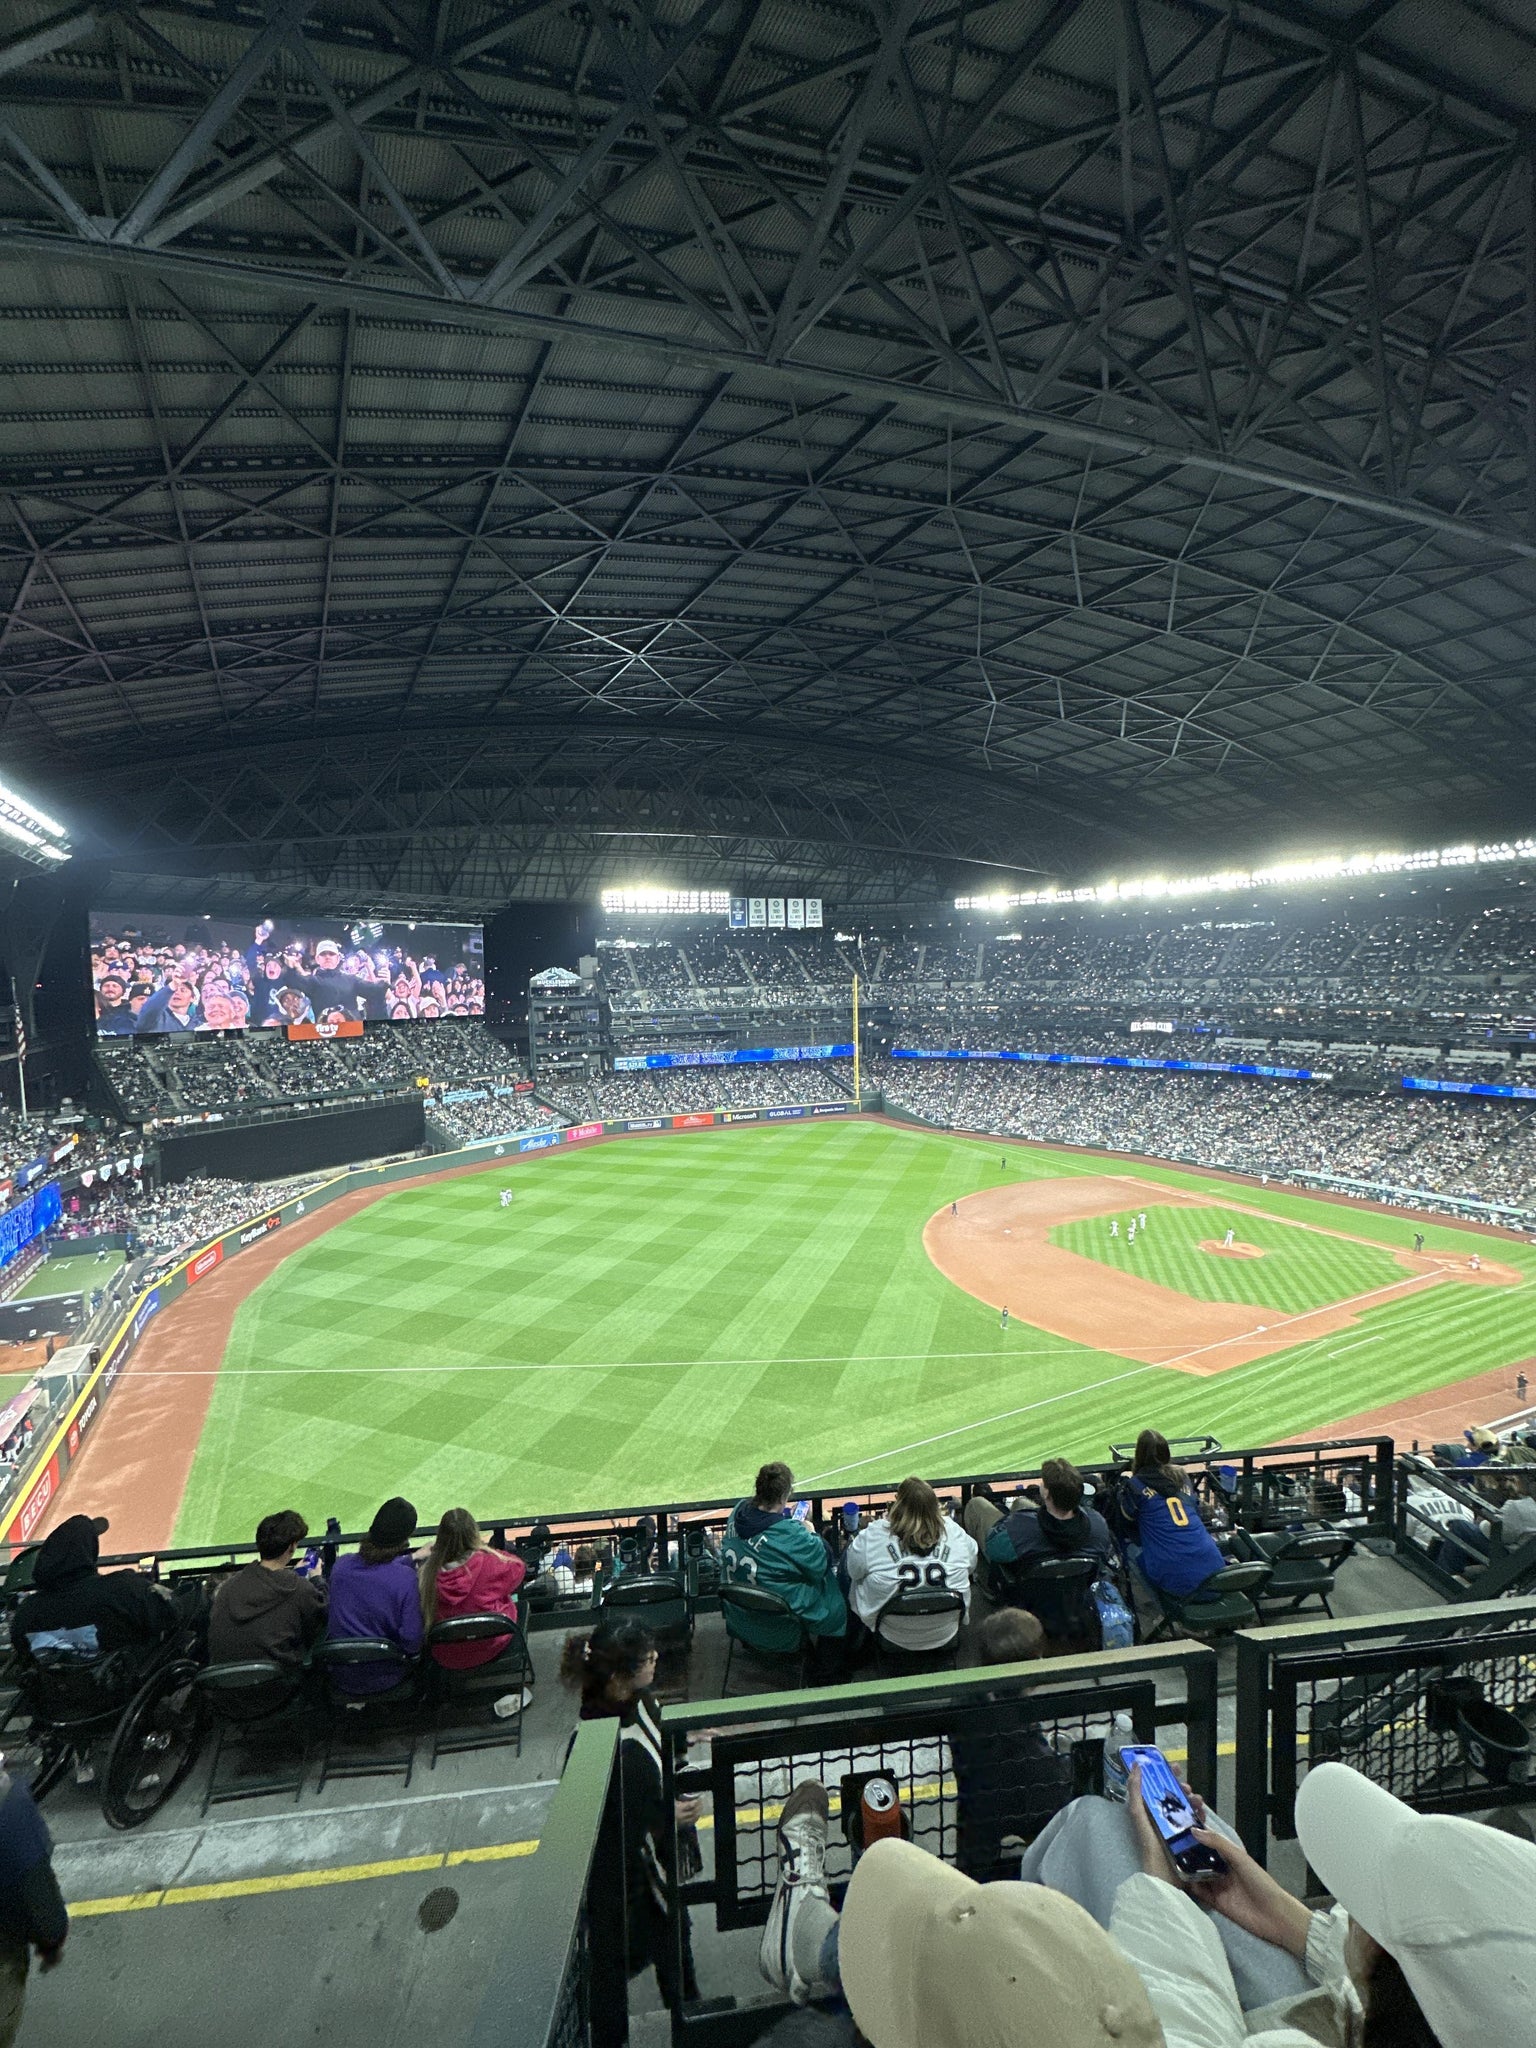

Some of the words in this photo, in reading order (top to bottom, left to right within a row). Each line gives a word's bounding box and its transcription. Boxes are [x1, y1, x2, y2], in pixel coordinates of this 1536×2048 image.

[732, 1112, 757, 1121] Microsoft
[522, 1137, 547, 1150] Alaska
[241, 1224, 267, 1244] KeyBank
[197, 1253, 215, 1272] Nintendo
[78, 1397, 97, 1432] TOYOTA
[23, 1482, 49, 1531] BECU
[1166, 1497, 1189, 1527] 0
[897, 1561, 947, 1593] 29
